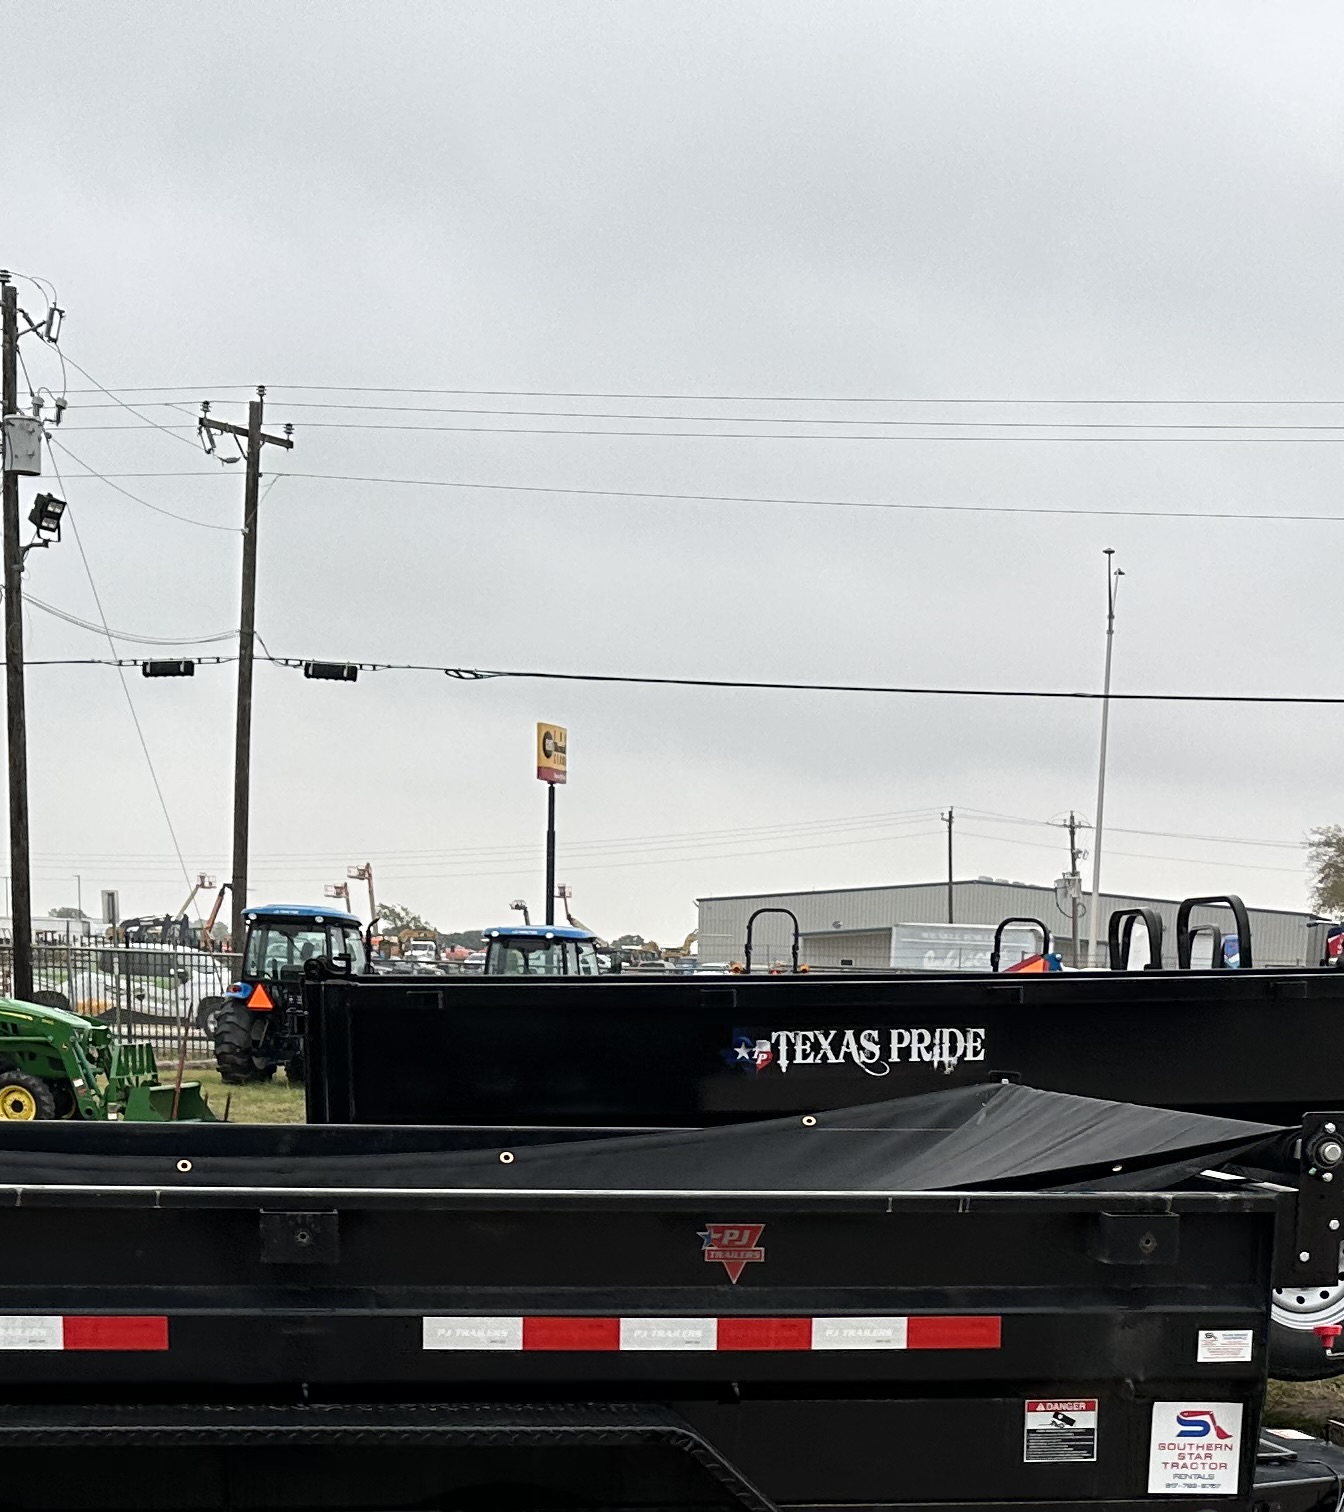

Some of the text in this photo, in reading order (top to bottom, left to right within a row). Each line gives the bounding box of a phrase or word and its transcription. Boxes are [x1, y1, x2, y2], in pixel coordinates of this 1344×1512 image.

[771, 1028, 986, 1077] TEXAS PRIDE
[721, 1229, 751, 1246] PJ
[709, 1250, 761, 1259] TRAILERS
[1045, 1402, 1087, 1411] DANGER
[1157, 1443, 1234, 1452] SOUTHERN
[1177, 1452, 1213, 1461] STAR
[1161, 1462, 1228, 1471] TRACTOR
